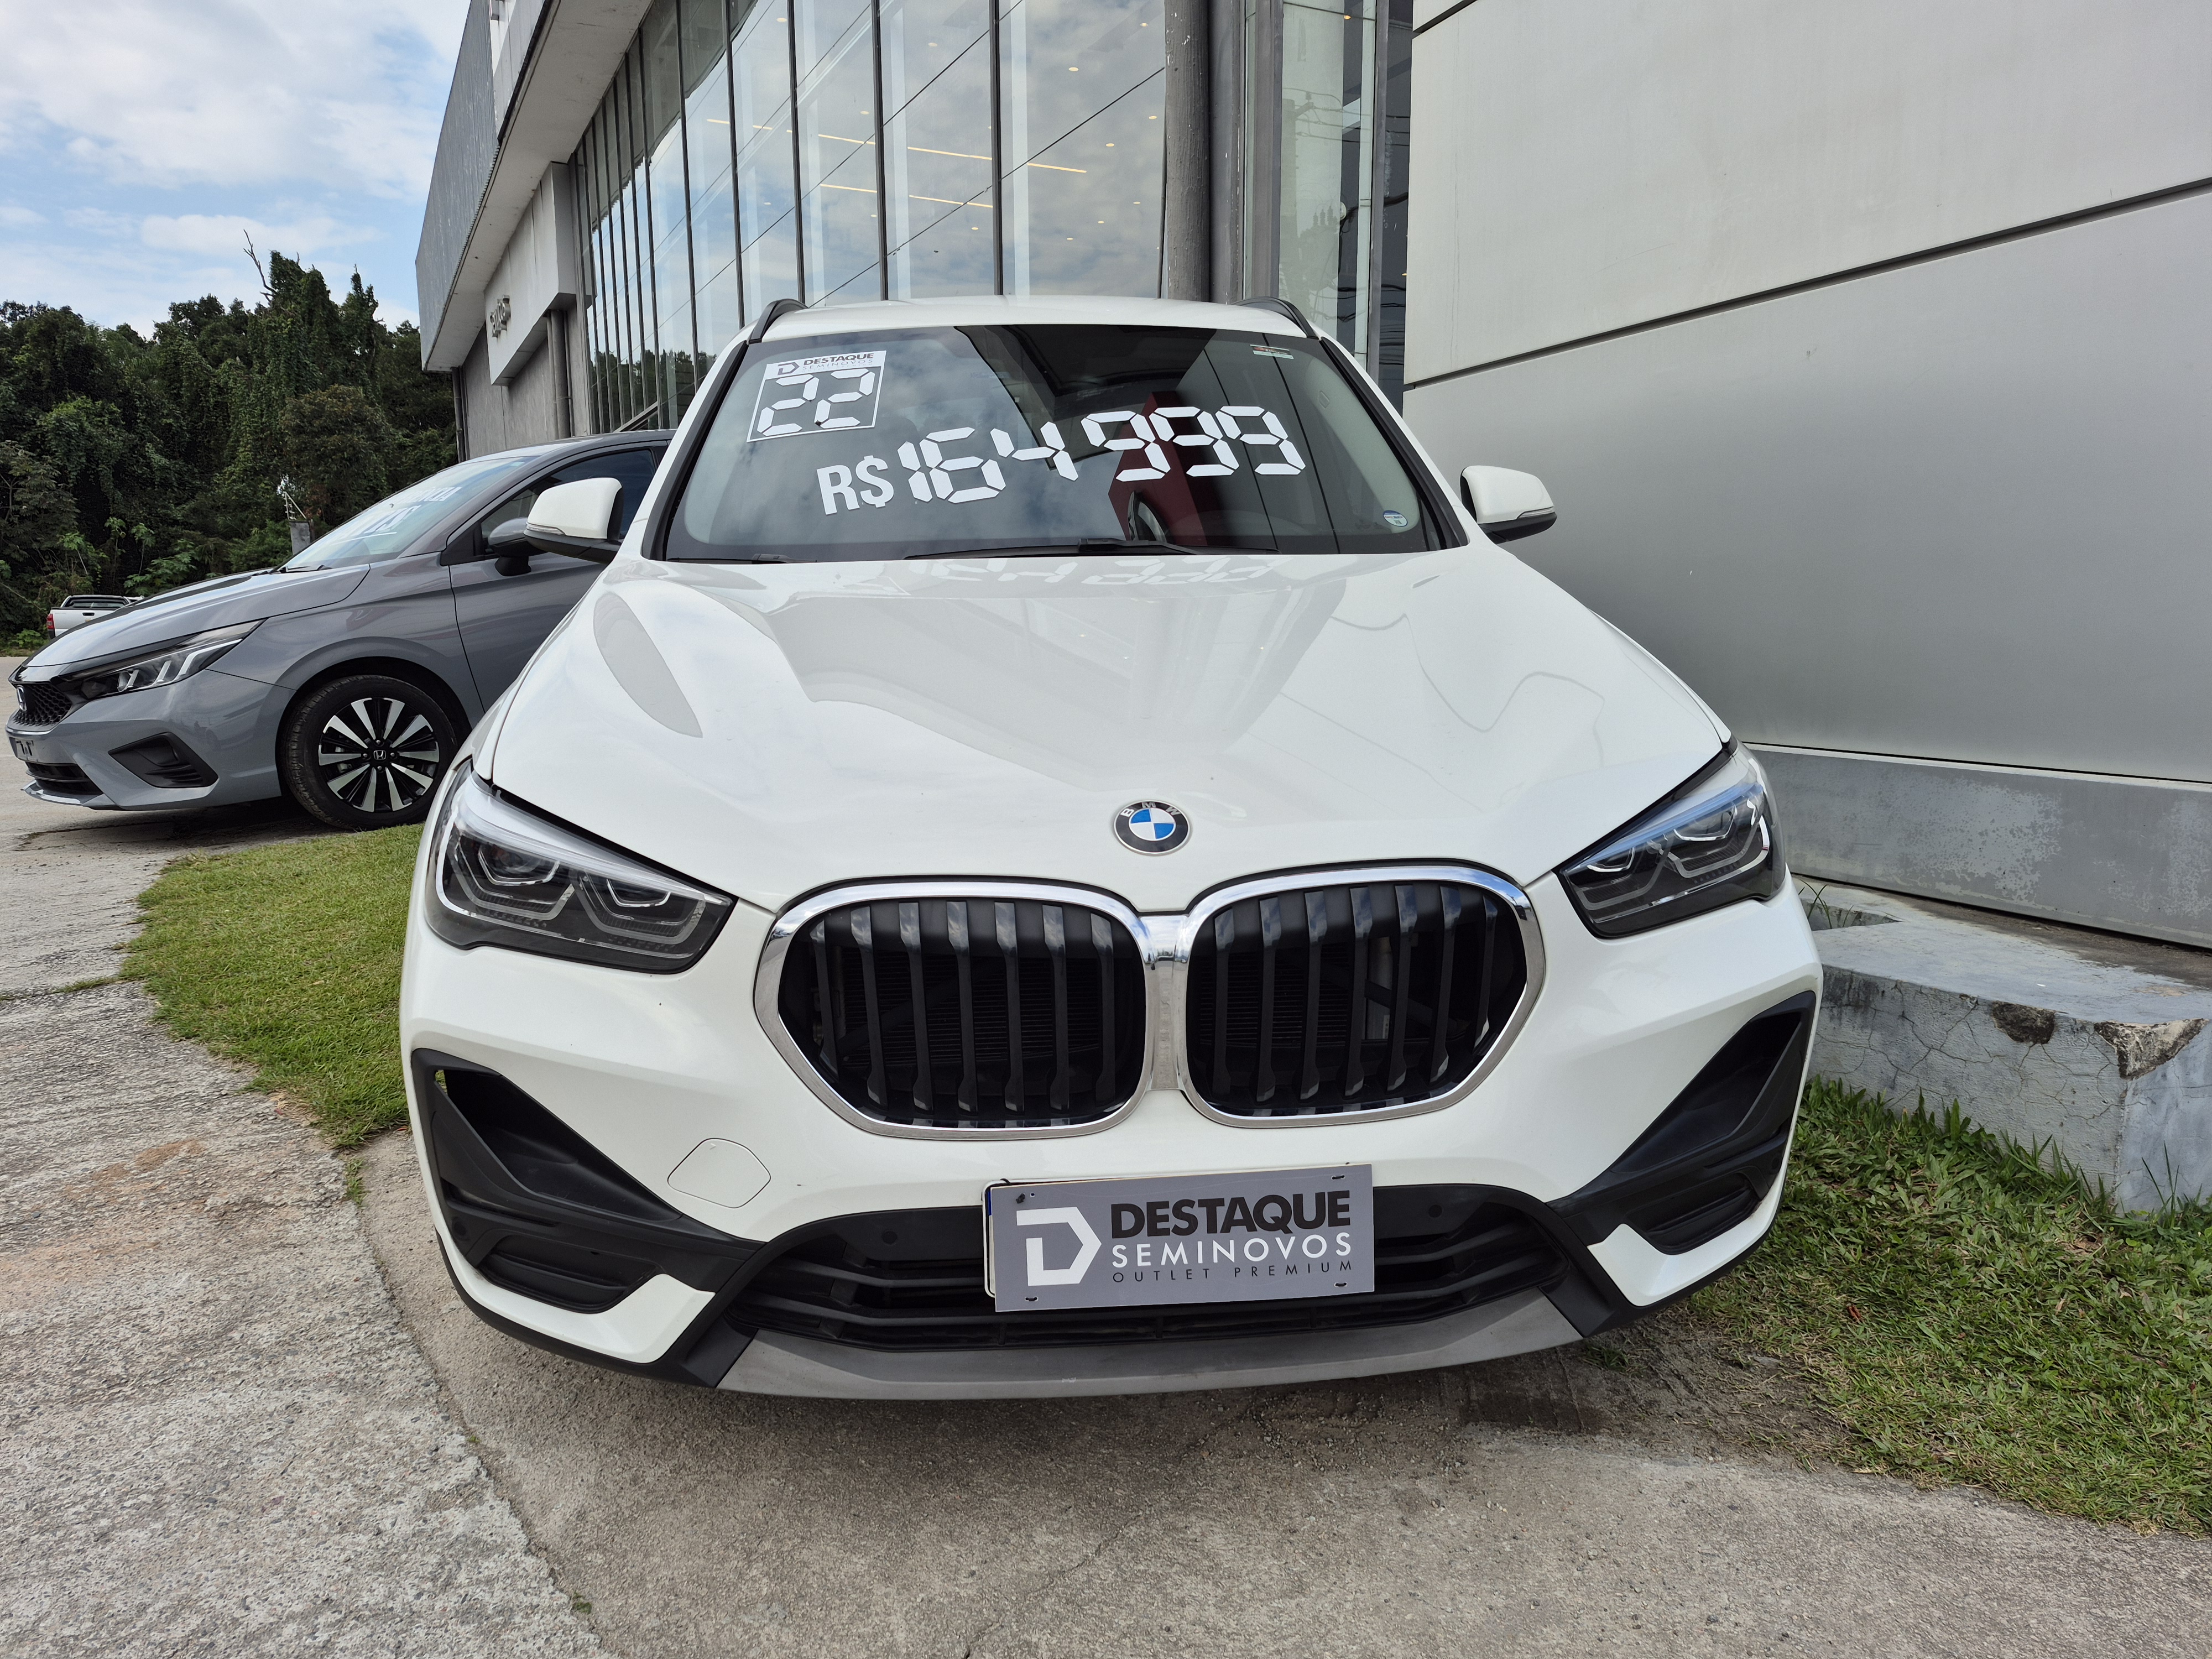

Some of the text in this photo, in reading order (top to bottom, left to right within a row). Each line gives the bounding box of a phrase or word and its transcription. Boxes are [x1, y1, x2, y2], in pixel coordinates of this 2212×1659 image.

[802, 359, 873, 370] SEMINOVOS
[804, 353, 874, 366] DESTAQUE
[757, 368, 875, 436] 22
[816, 455, 894, 515] R$
[1120, 801, 1182, 818] BMW
[1110, 1190, 1351, 1239] DESTAQUE
[1112, 1232, 1352, 1268] SEMINOVOS
[1112, 1260, 1352, 1283] OUTLET PREMIUM
